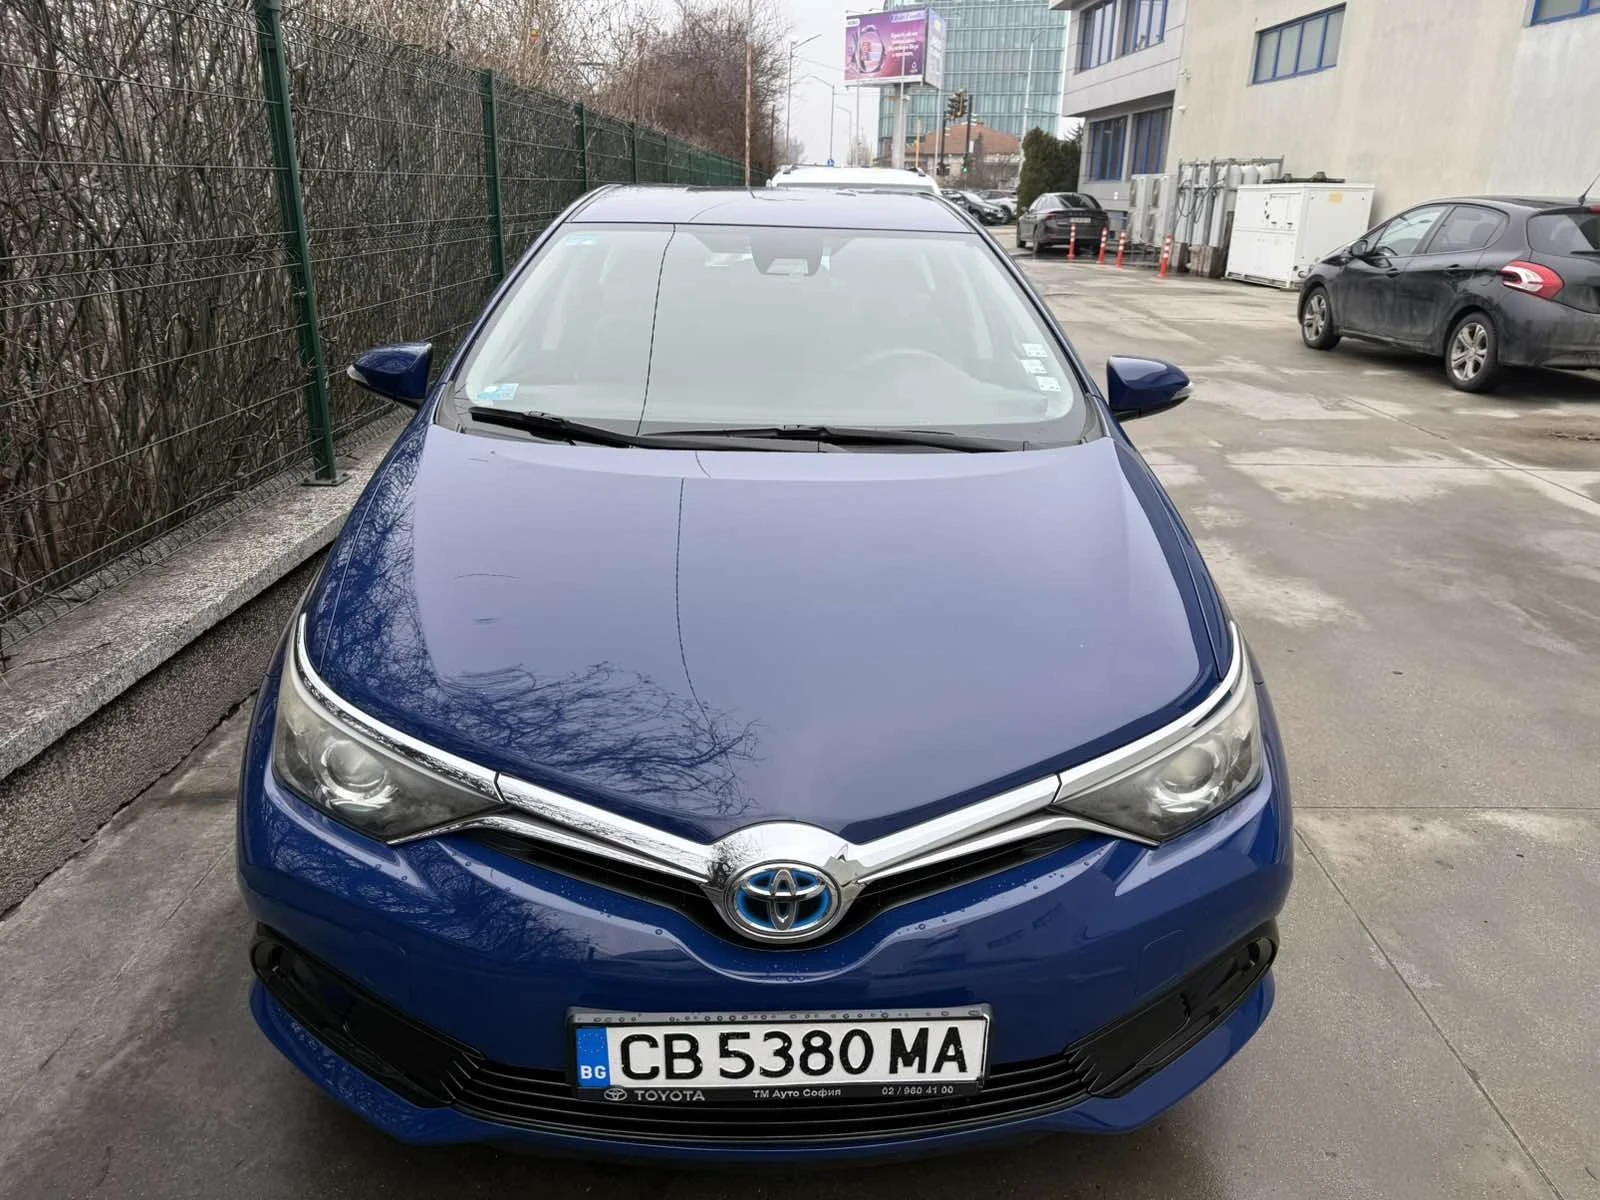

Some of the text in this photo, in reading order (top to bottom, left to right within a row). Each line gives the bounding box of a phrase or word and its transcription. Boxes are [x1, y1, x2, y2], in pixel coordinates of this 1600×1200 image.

[619, 1026, 969, 1081] CB 5380 MA
[580, 1065, 607, 1080] BG
[634, 1090, 705, 1102] TOYOTA
[771, 1089, 800, 1100] Ауто
[802, 1088, 841, 1099] София
[881, 1085, 895, 1096] 02
[940, 1084, 954, 1095] 00
